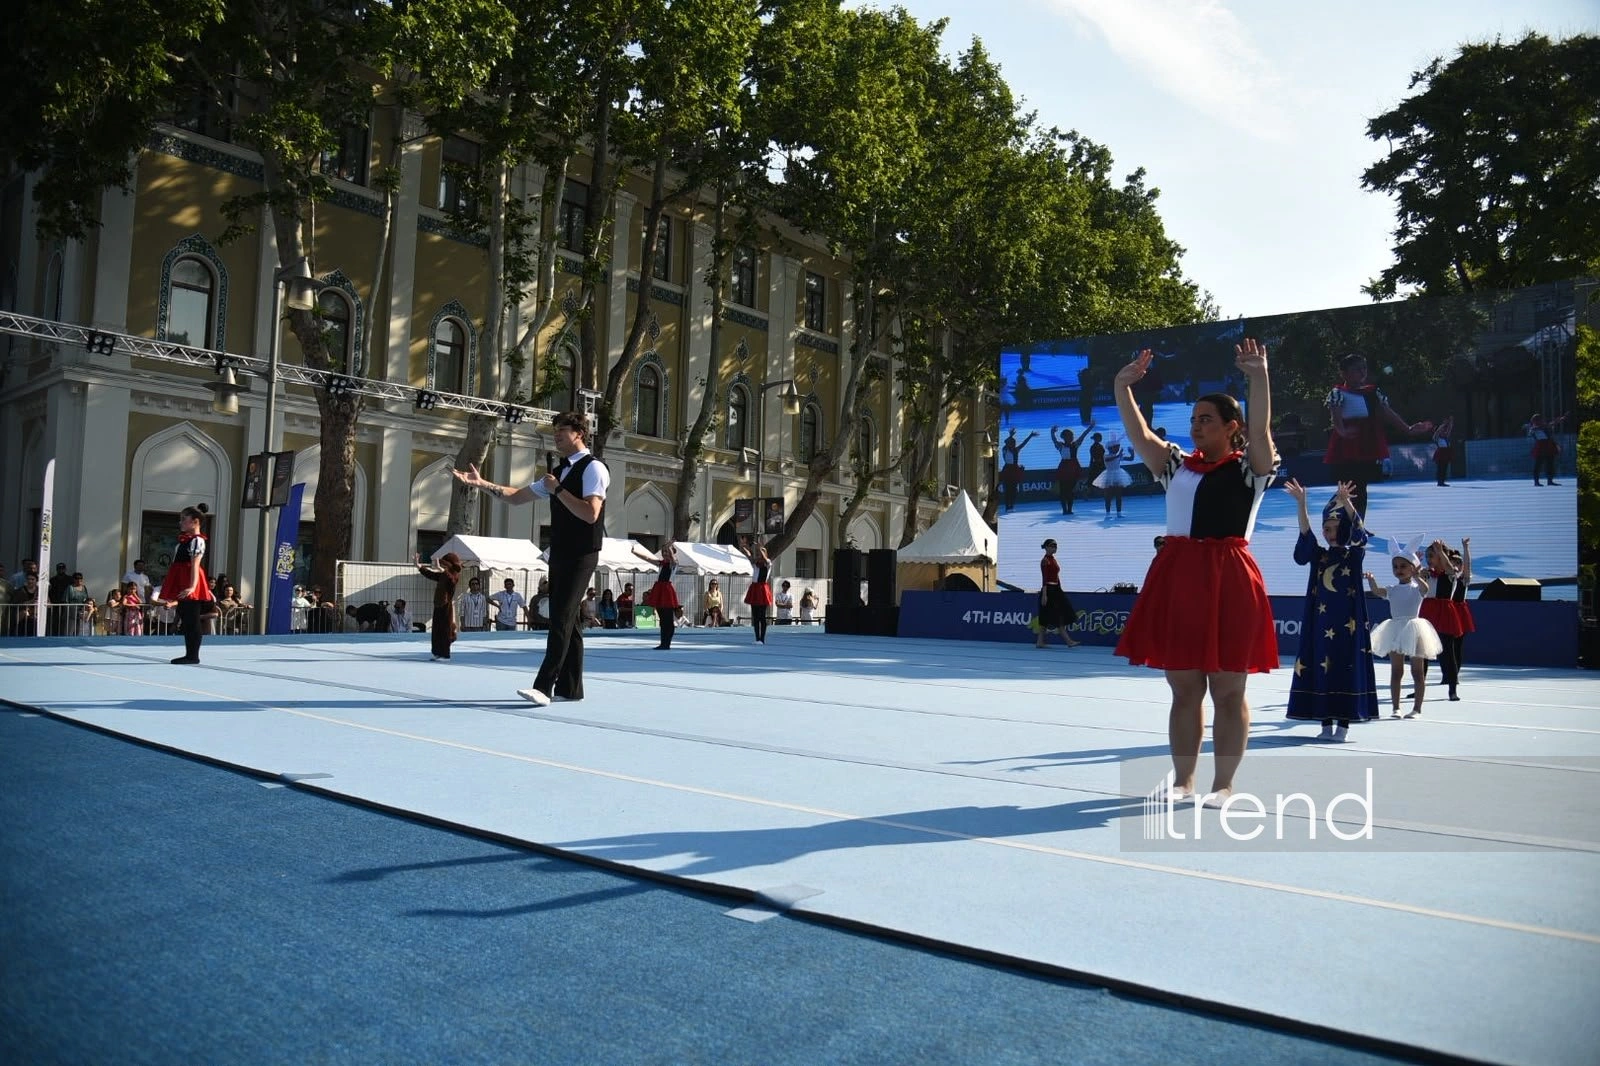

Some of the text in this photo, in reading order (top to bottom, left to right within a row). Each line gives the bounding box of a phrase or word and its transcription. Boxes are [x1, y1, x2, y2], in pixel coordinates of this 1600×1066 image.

[1022, 481, 1052, 492] BAKU
[962, 610, 991, 624] 4TH
[993, 611, 1032, 625] BAKU
